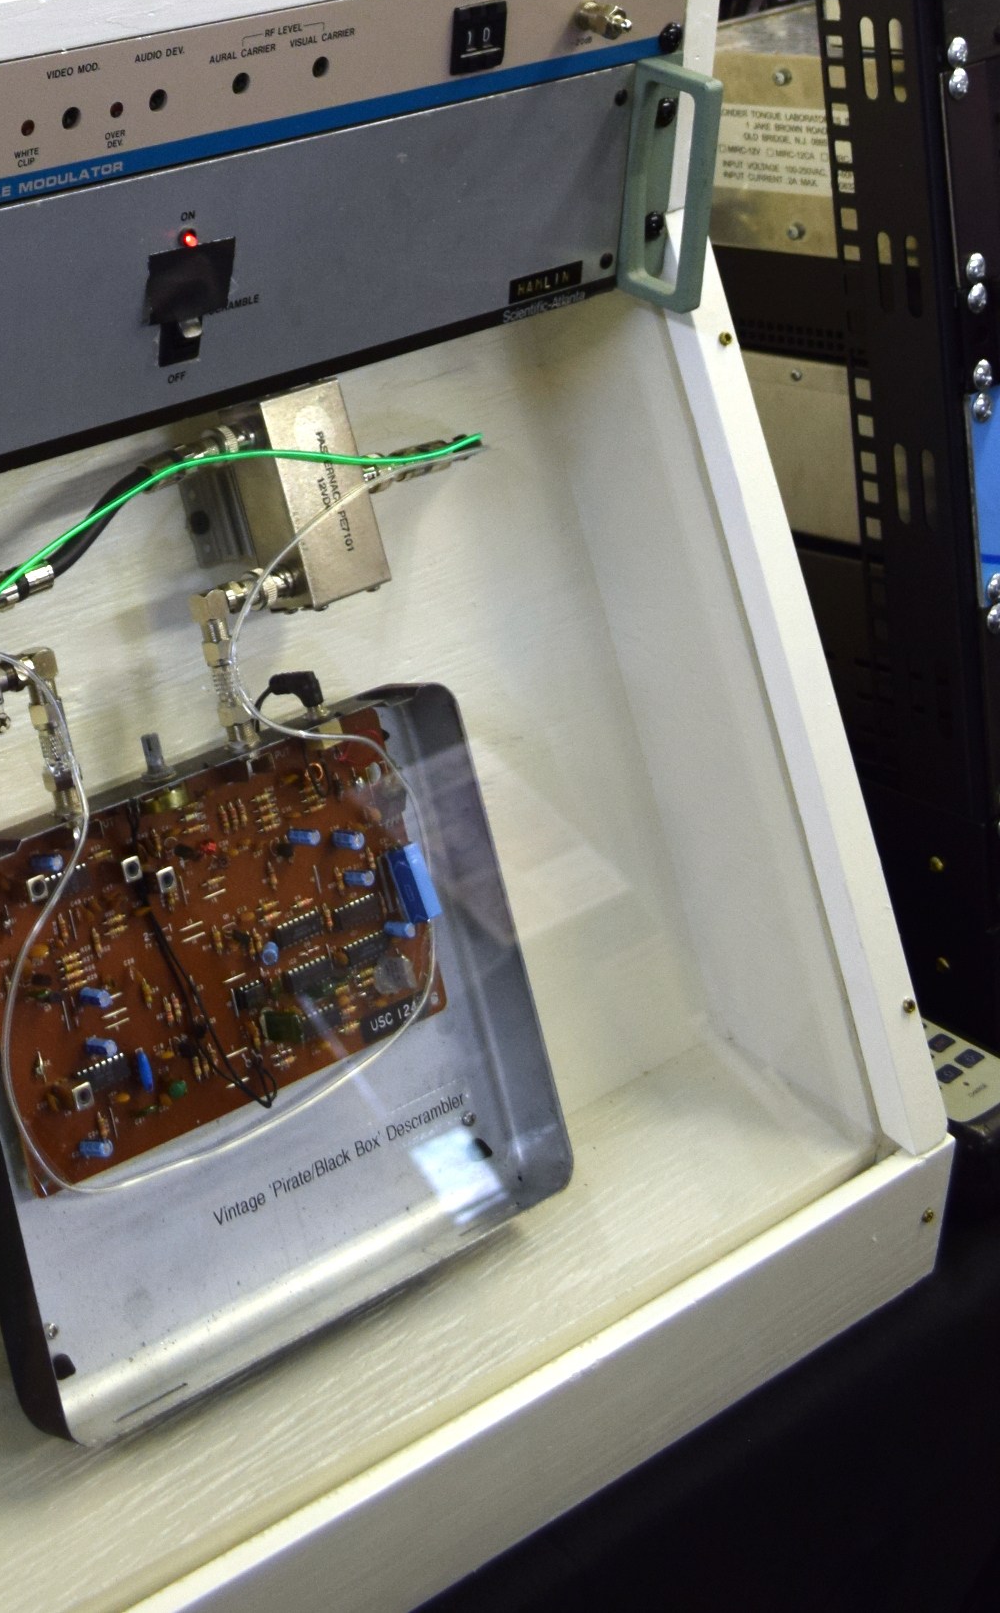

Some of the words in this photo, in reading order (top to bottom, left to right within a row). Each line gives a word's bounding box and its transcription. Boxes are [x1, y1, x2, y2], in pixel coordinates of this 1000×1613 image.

[264, 27, 275, 37] RF
[277, 23, 303, 36] LEVEL
[289, 35, 318, 48] VISUAL
[321, 28, 355, 42] CARRIER
[134, 50, 162, 63] AUDIO
[165, 45, 185, 57] DEV.
[209, 52, 237, 64] AURAL
[241, 43, 276, 57] CARRIER
[46, 67, 74, 80] VIDEO
[77, 62, 100, 74] MOD.
[104, 129, 126, 141] OVER
[14, 147, 39, 160] WHITE
[18, 157, 35, 168] CLIP
[18, 161, 124, 194] MODULATOR
[181, 210, 196, 222] ON
[168, 371, 186, 384] OFF
[337, 509, 355, 552] PE7101
[370, 1012, 394, 1031] USC
[213, 1190, 267, 1226] Vintage
[385, 1093, 465, 1142] Descrambler
